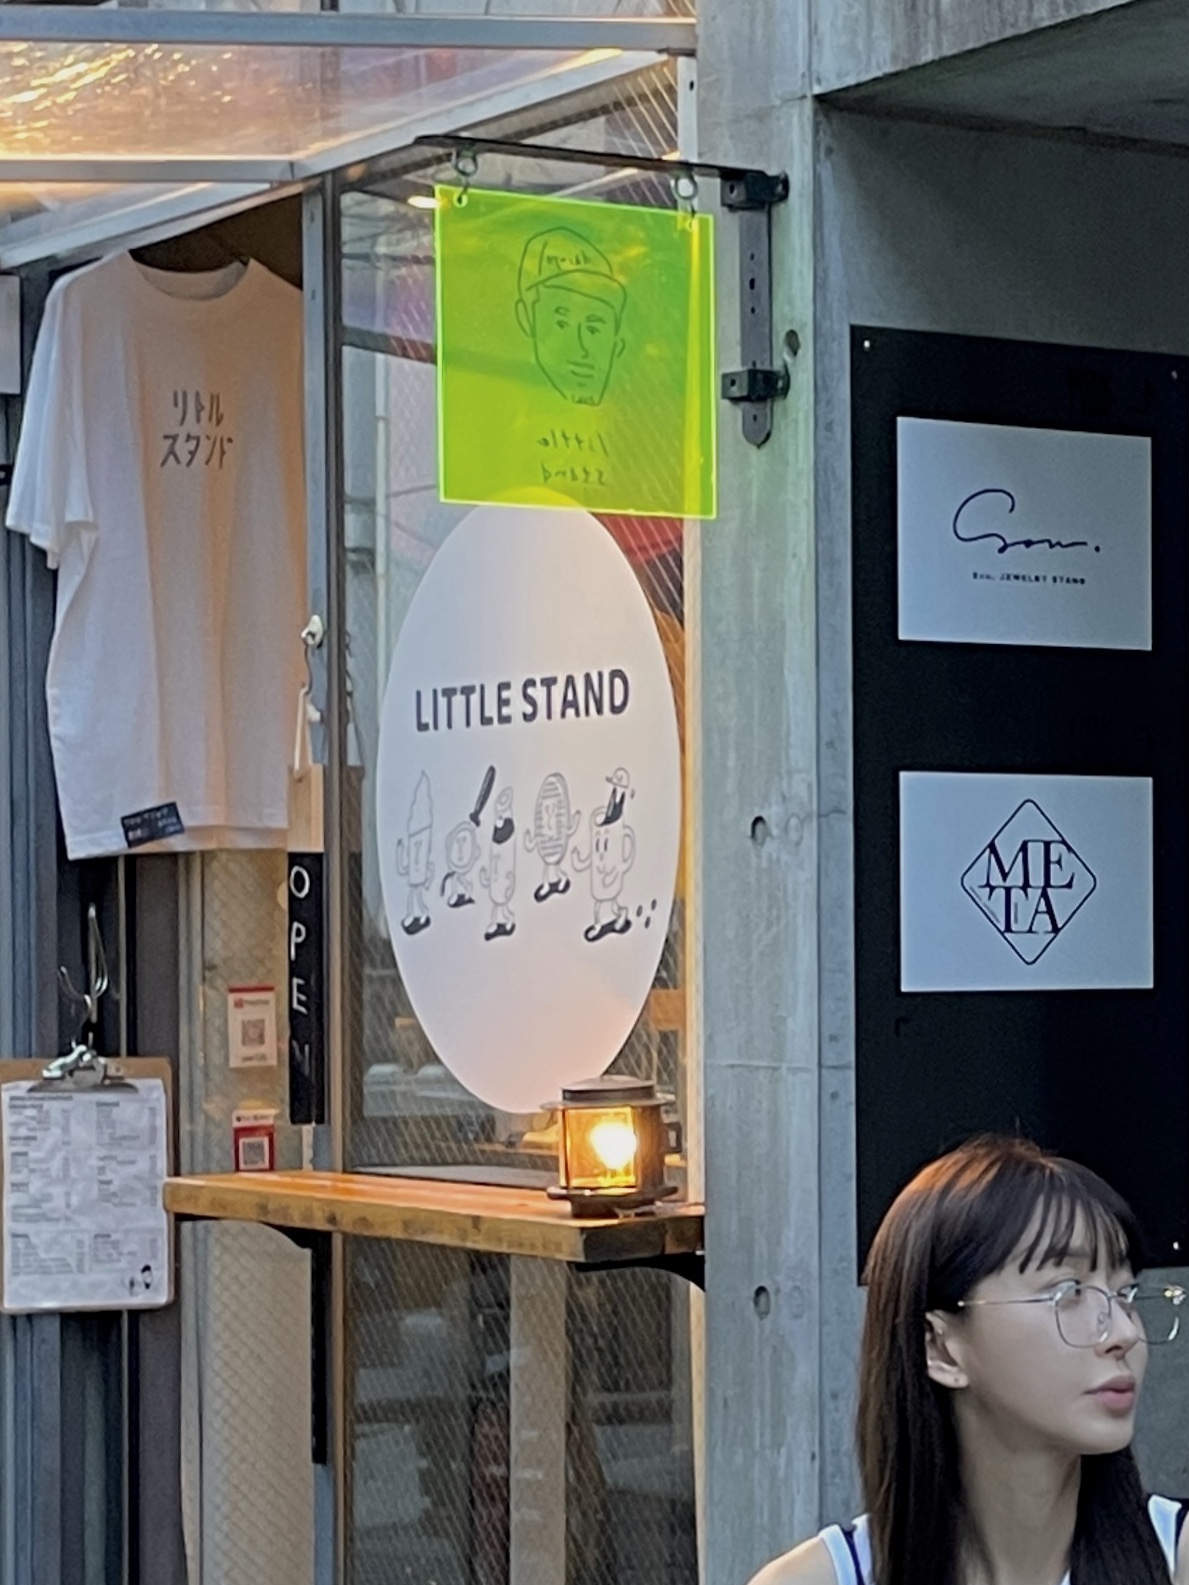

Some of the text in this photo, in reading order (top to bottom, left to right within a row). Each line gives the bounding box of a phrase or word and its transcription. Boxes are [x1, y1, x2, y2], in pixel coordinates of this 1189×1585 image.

[173, 390, 224, 427] リトル
[161, 432, 233, 469] スタンド
[416, 668, 630, 732] LITTLE STAND
[289, 865, 310, 1077] OPEN
